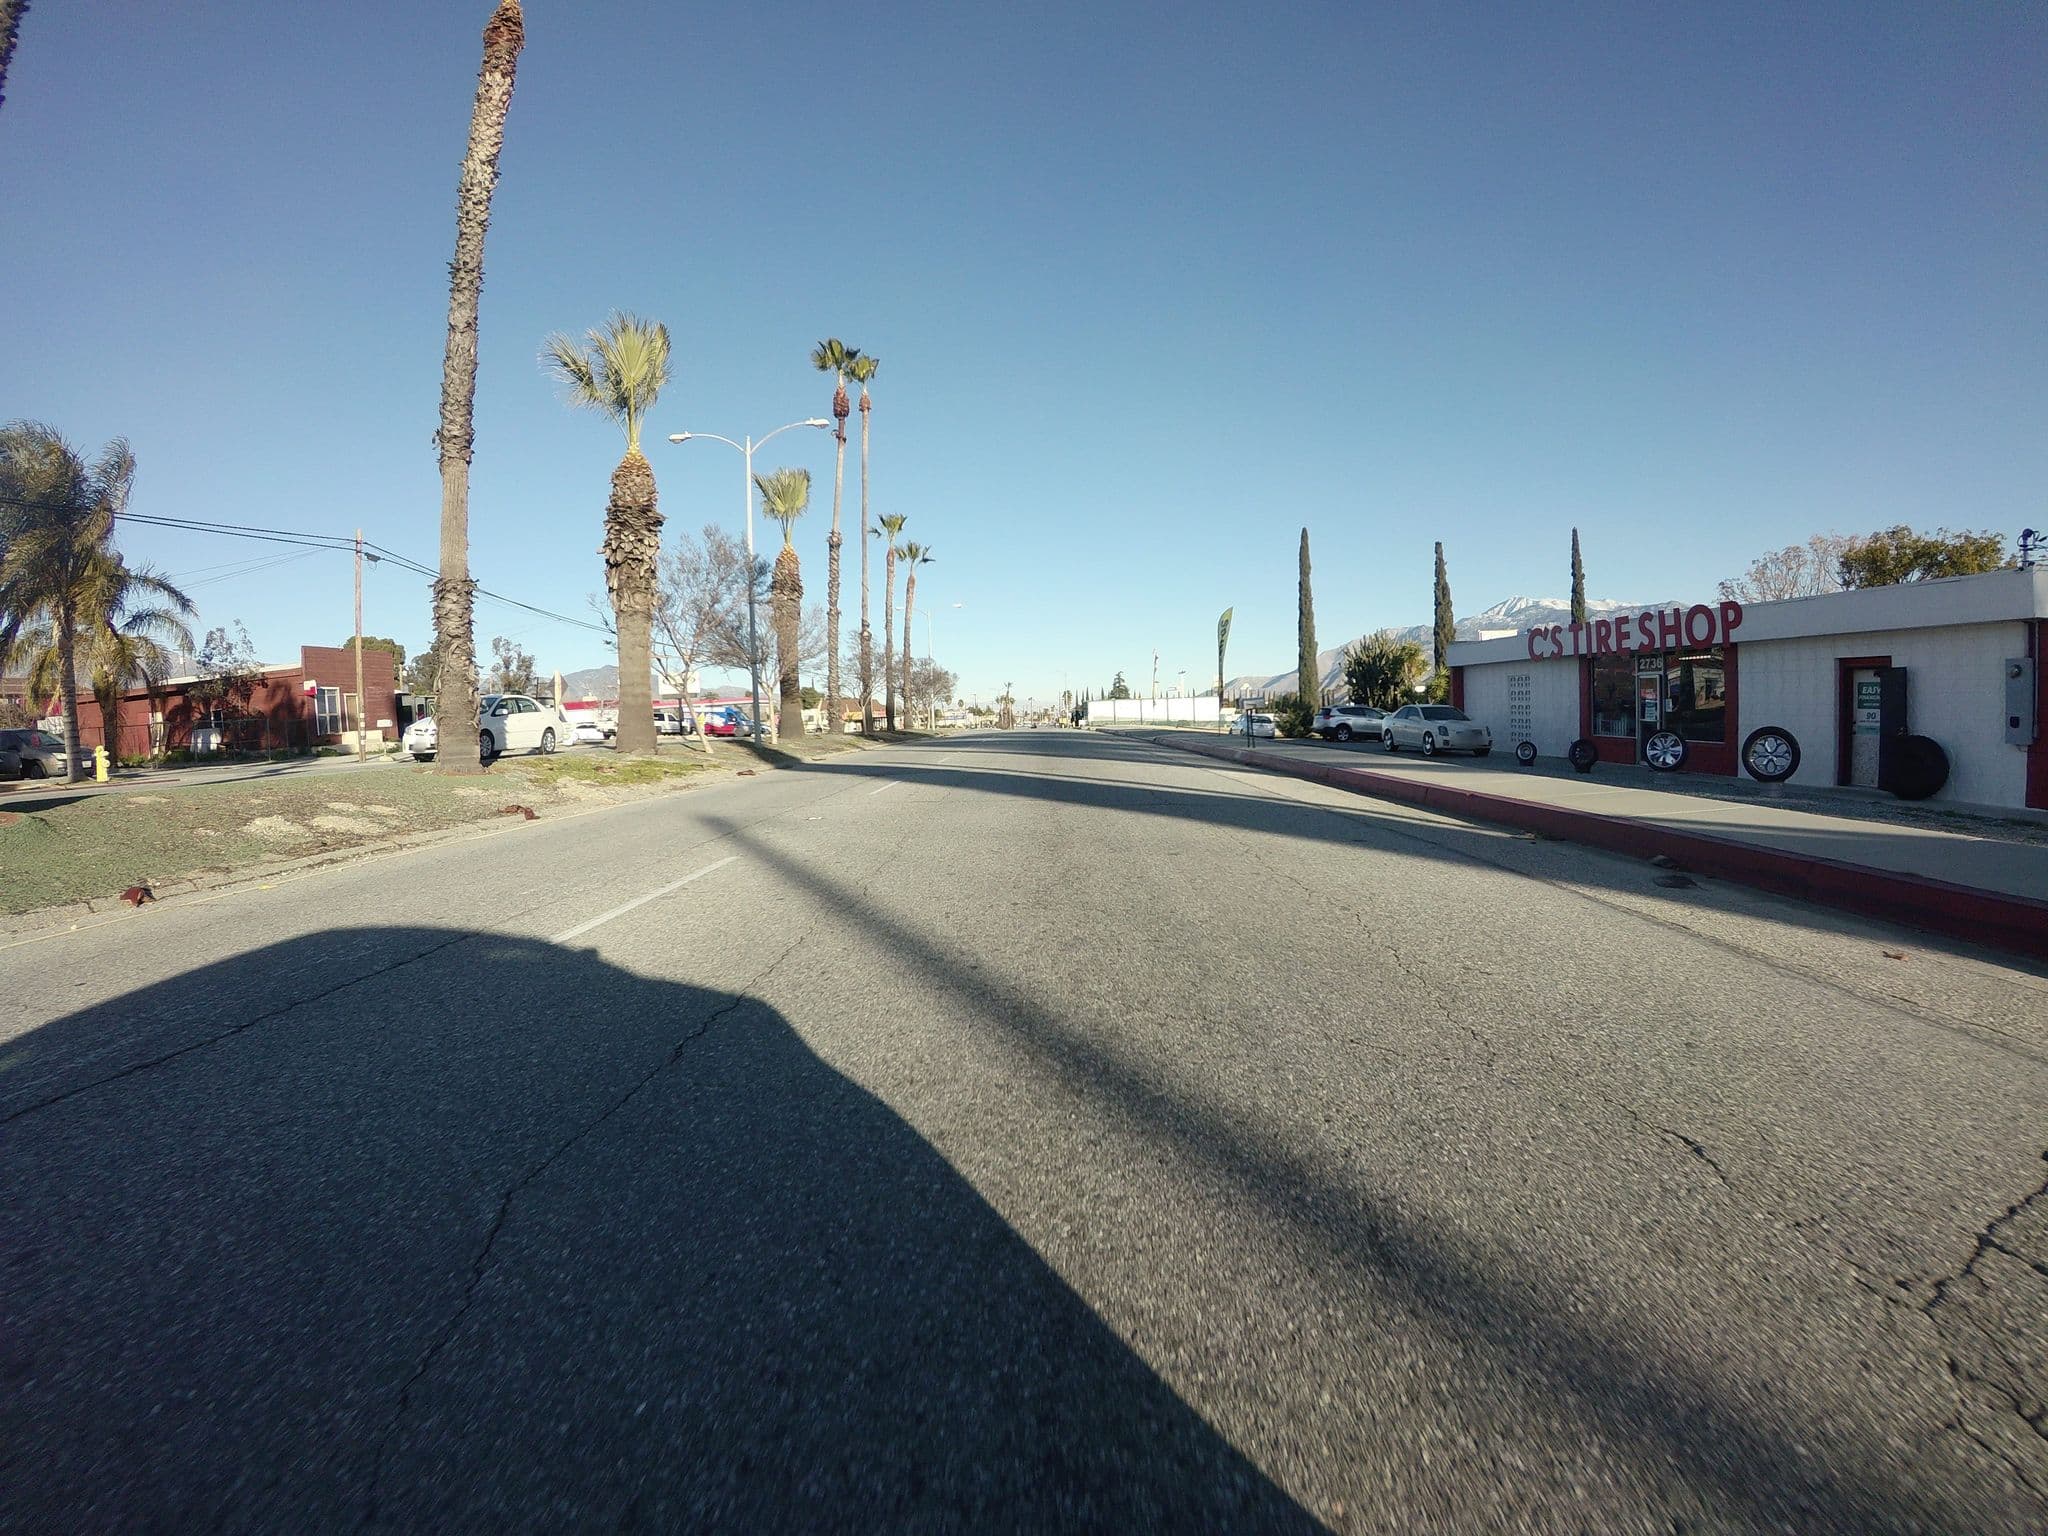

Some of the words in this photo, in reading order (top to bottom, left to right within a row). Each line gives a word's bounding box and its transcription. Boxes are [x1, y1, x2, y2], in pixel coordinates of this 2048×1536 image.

[1528, 625, 1563, 662] C'S
[1568, 615, 1631, 659] TIRE
[1638, 601, 1743, 653] SHOP
[1640, 658, 1662, 670] 2736
[1862, 686, 1880, 694] EASY
